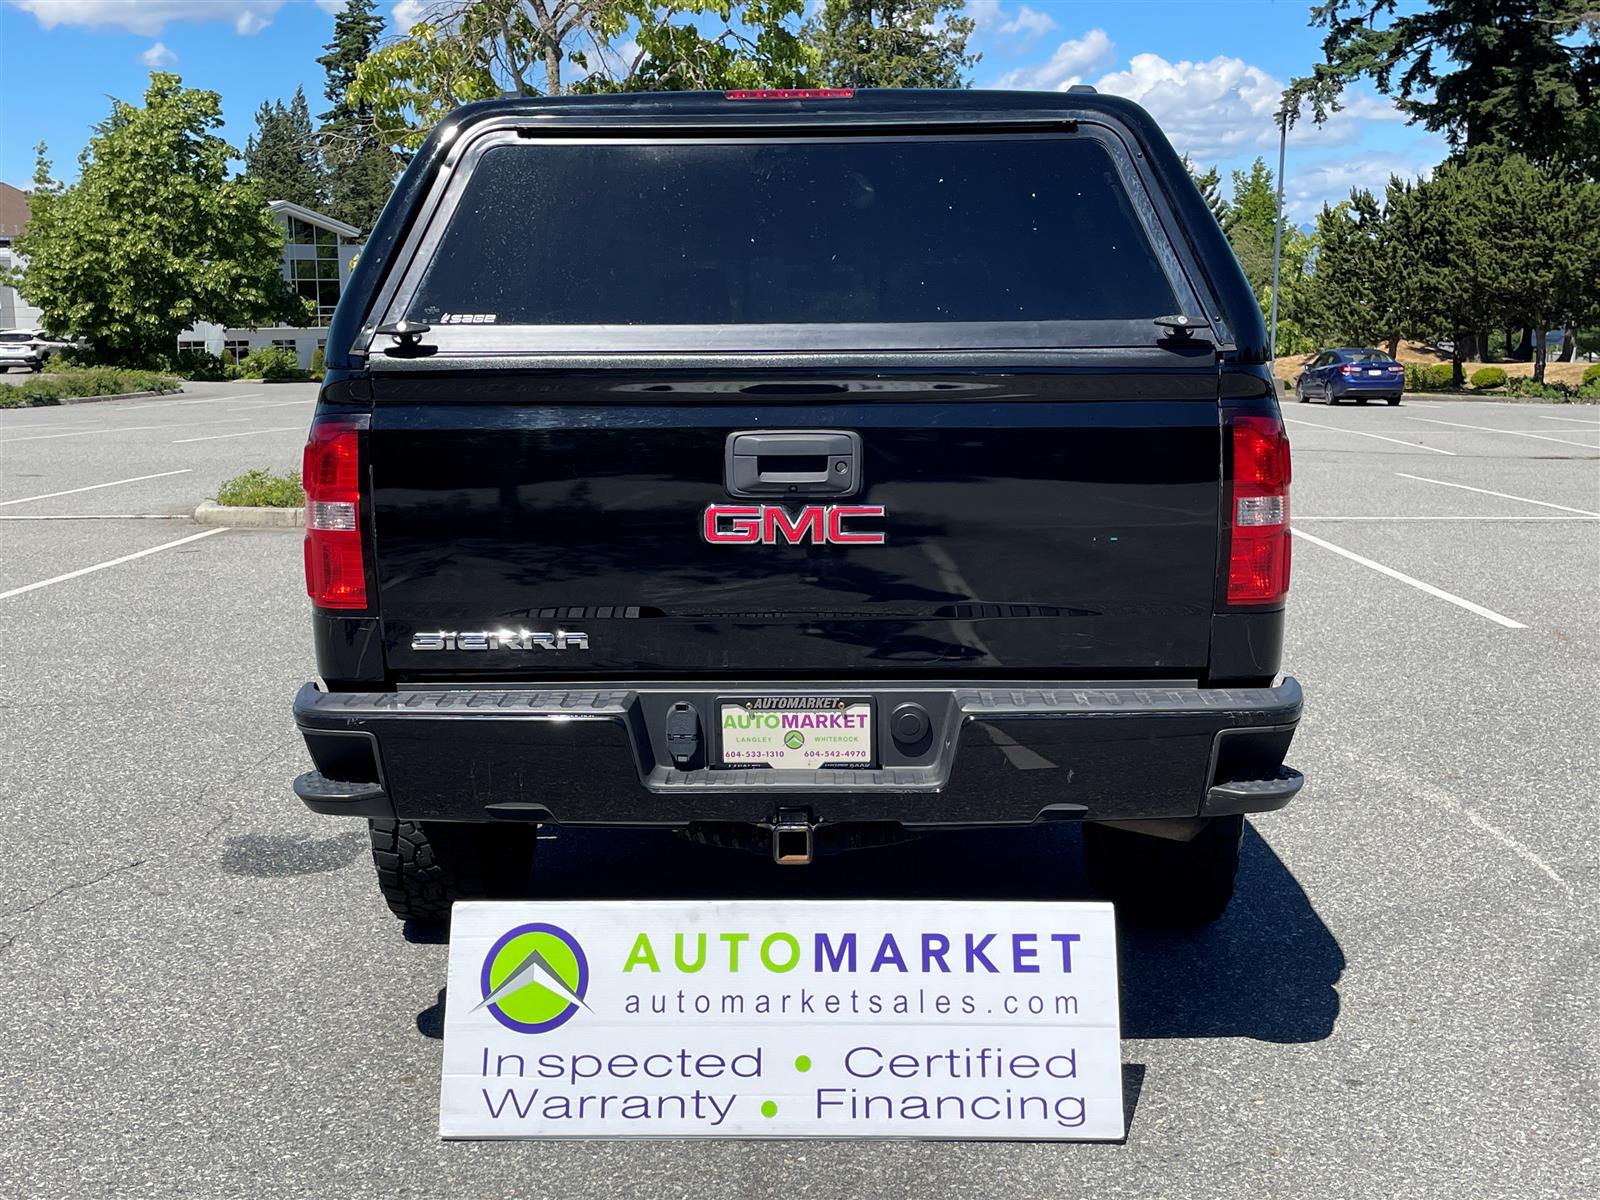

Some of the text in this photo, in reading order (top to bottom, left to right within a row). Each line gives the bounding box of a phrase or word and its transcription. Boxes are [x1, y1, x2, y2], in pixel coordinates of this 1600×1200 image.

[703, 503, 886, 545] GMC
[411, 630, 590, 651] SIERRA
[753, 697, 840, 710] AUTOMARKET
[723, 714, 868, 729] AUTOMARKET
[804, 750, 866, 758] 604-542-4970
[621, 932, 1081, 974] AUTOMARKET
[624, 988, 1079, 1015] automarketsales.com
[481, 1046, 1078, 1084] Inspected Certified
[482, 1088, 1088, 1128] Warranty Financing
